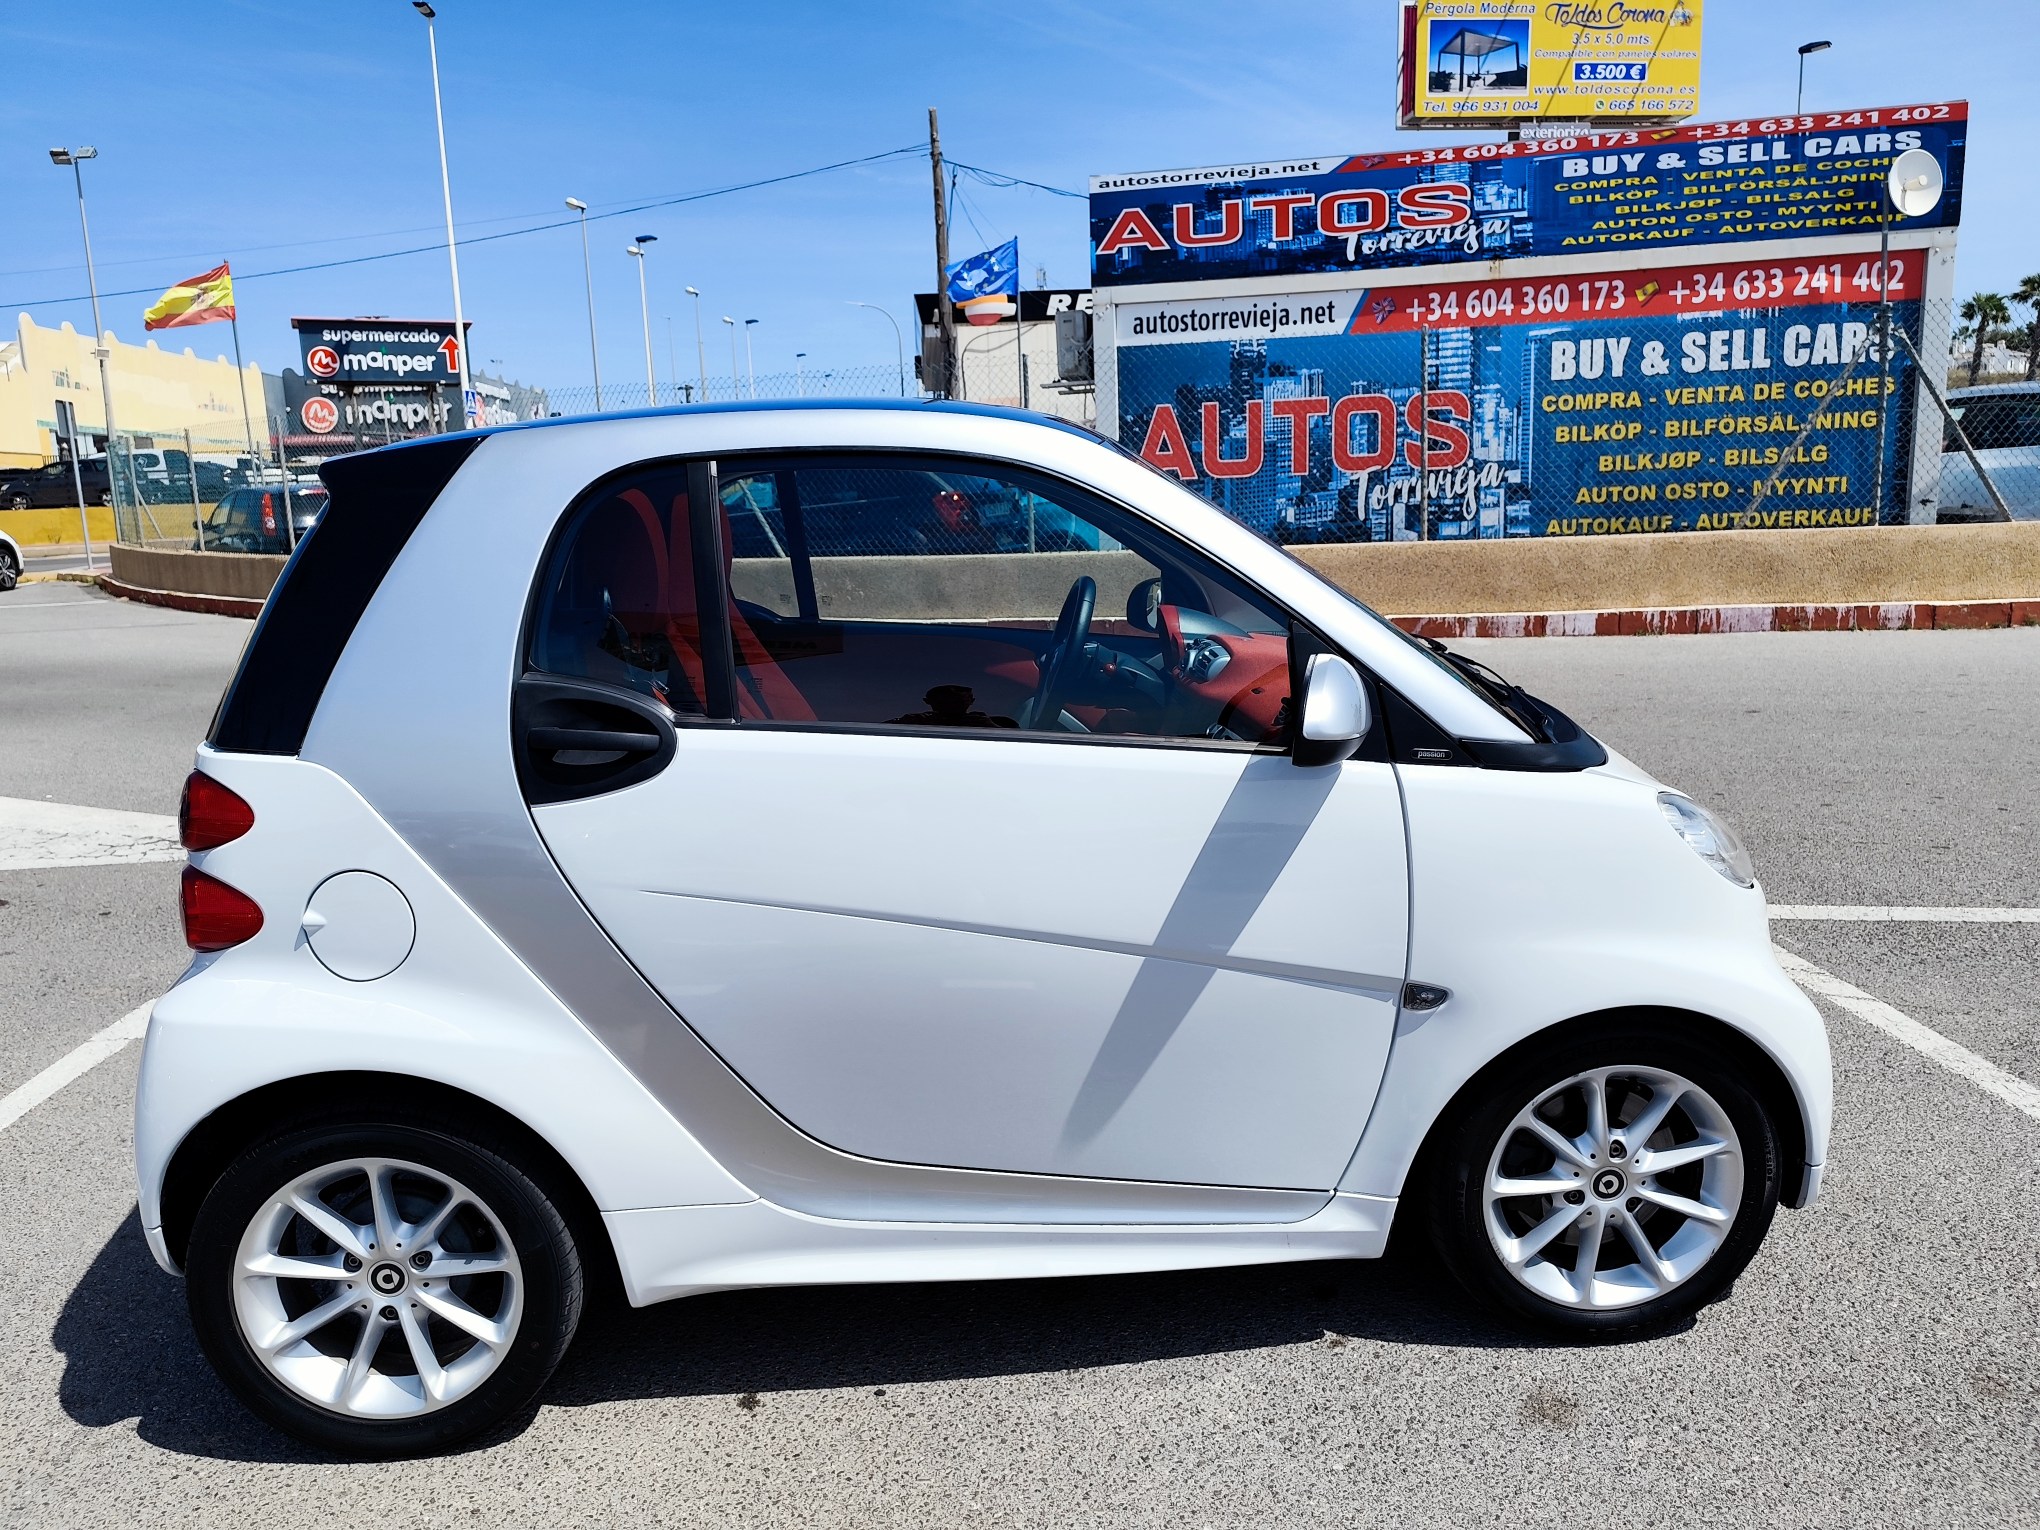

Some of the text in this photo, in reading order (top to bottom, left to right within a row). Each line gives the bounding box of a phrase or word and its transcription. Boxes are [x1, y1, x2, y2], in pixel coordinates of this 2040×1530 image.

[1480, 2, 1536, 14] Moderna
[1545, 1, 1665, 28] Toldos Corona
[1534, 49, 1697, 60] Compatible con paneles solares
[1594, 36, 1601, 44] x
[1627, 34, 1653, 45] mts.
[1579, 64, 1643, 80] 3.500 €
[1534, 84, 1696, 95] www.toldoscorona.es
[1423, 100, 1539, 112] Tel. 966 931 004
[1641, 100, 1665, 110] 166
[1668, 100, 1694, 110] 572
[1687, 105, 1951, 138] +34 633 241 402
[1398, 131, 1639, 164] +34 604 360 173
[1562, 130, 1922, 178] BUY & SELL CARS
[1098, 161, 1321, 189] autostorrevieja.net
[1554, 176, 1658, 192] COMPRA
[1682, 166, 1766, 181] VENTA
[1774, 163, 1808, 175] DE
[1817, 157, 1897, 171] COCH
[1569, 189, 1659, 205] BILKÖP
[1683, 172, 1886, 196] BILFÖRSÄLJNIN
[1592, 215, 1677, 230] AUTON
[1685, 209, 1753, 223] OSTO
[1777, 200, 1878, 216] MYYNTI
[1615, 198, 1722, 215] BILKJØP
[1746, 188, 1855, 205] BILSALG
[1096, 181, 1473, 256] AUTOS
[1561, 227, 1695, 246] AUTOKAUF
[1719, 213, 1908, 235] AUTOVERKAUF
[1342, 217, 1510, 262] Torrevieja
[1668, 259, 1905, 305] +34 633 241 402
[1405, 279, 1626, 323] +34 604 360 173
[1132, 300, 1336, 336] autostorrevieja.net
[322, 329, 440, 345] supermercado
[1551, 322, 1895, 381] BUY & SELL CARS
[343, 351, 437, 377] manper
[1541, 391, 1643, 413] COMPRA
[1664, 385, 1745, 406] VENTA
[1753, 382, 1786, 401] DE
[1140, 390, 1471, 480] AUTOS
[1555, 421, 1643, 443] BILKÖP
[1664, 410, 1878, 438] BILFÖRSÄLNING
[1599, 451, 1701, 472] BILKJØP
[1350, 458, 1506, 522] Torrvieja
[1575, 484, 1656, 504] AUTON
[1664, 481, 1730, 500] OSTO
[1546, 515, 1673, 535] AUTOKAUF
[1696, 508, 1872, 529] AUTOVERKAUF
